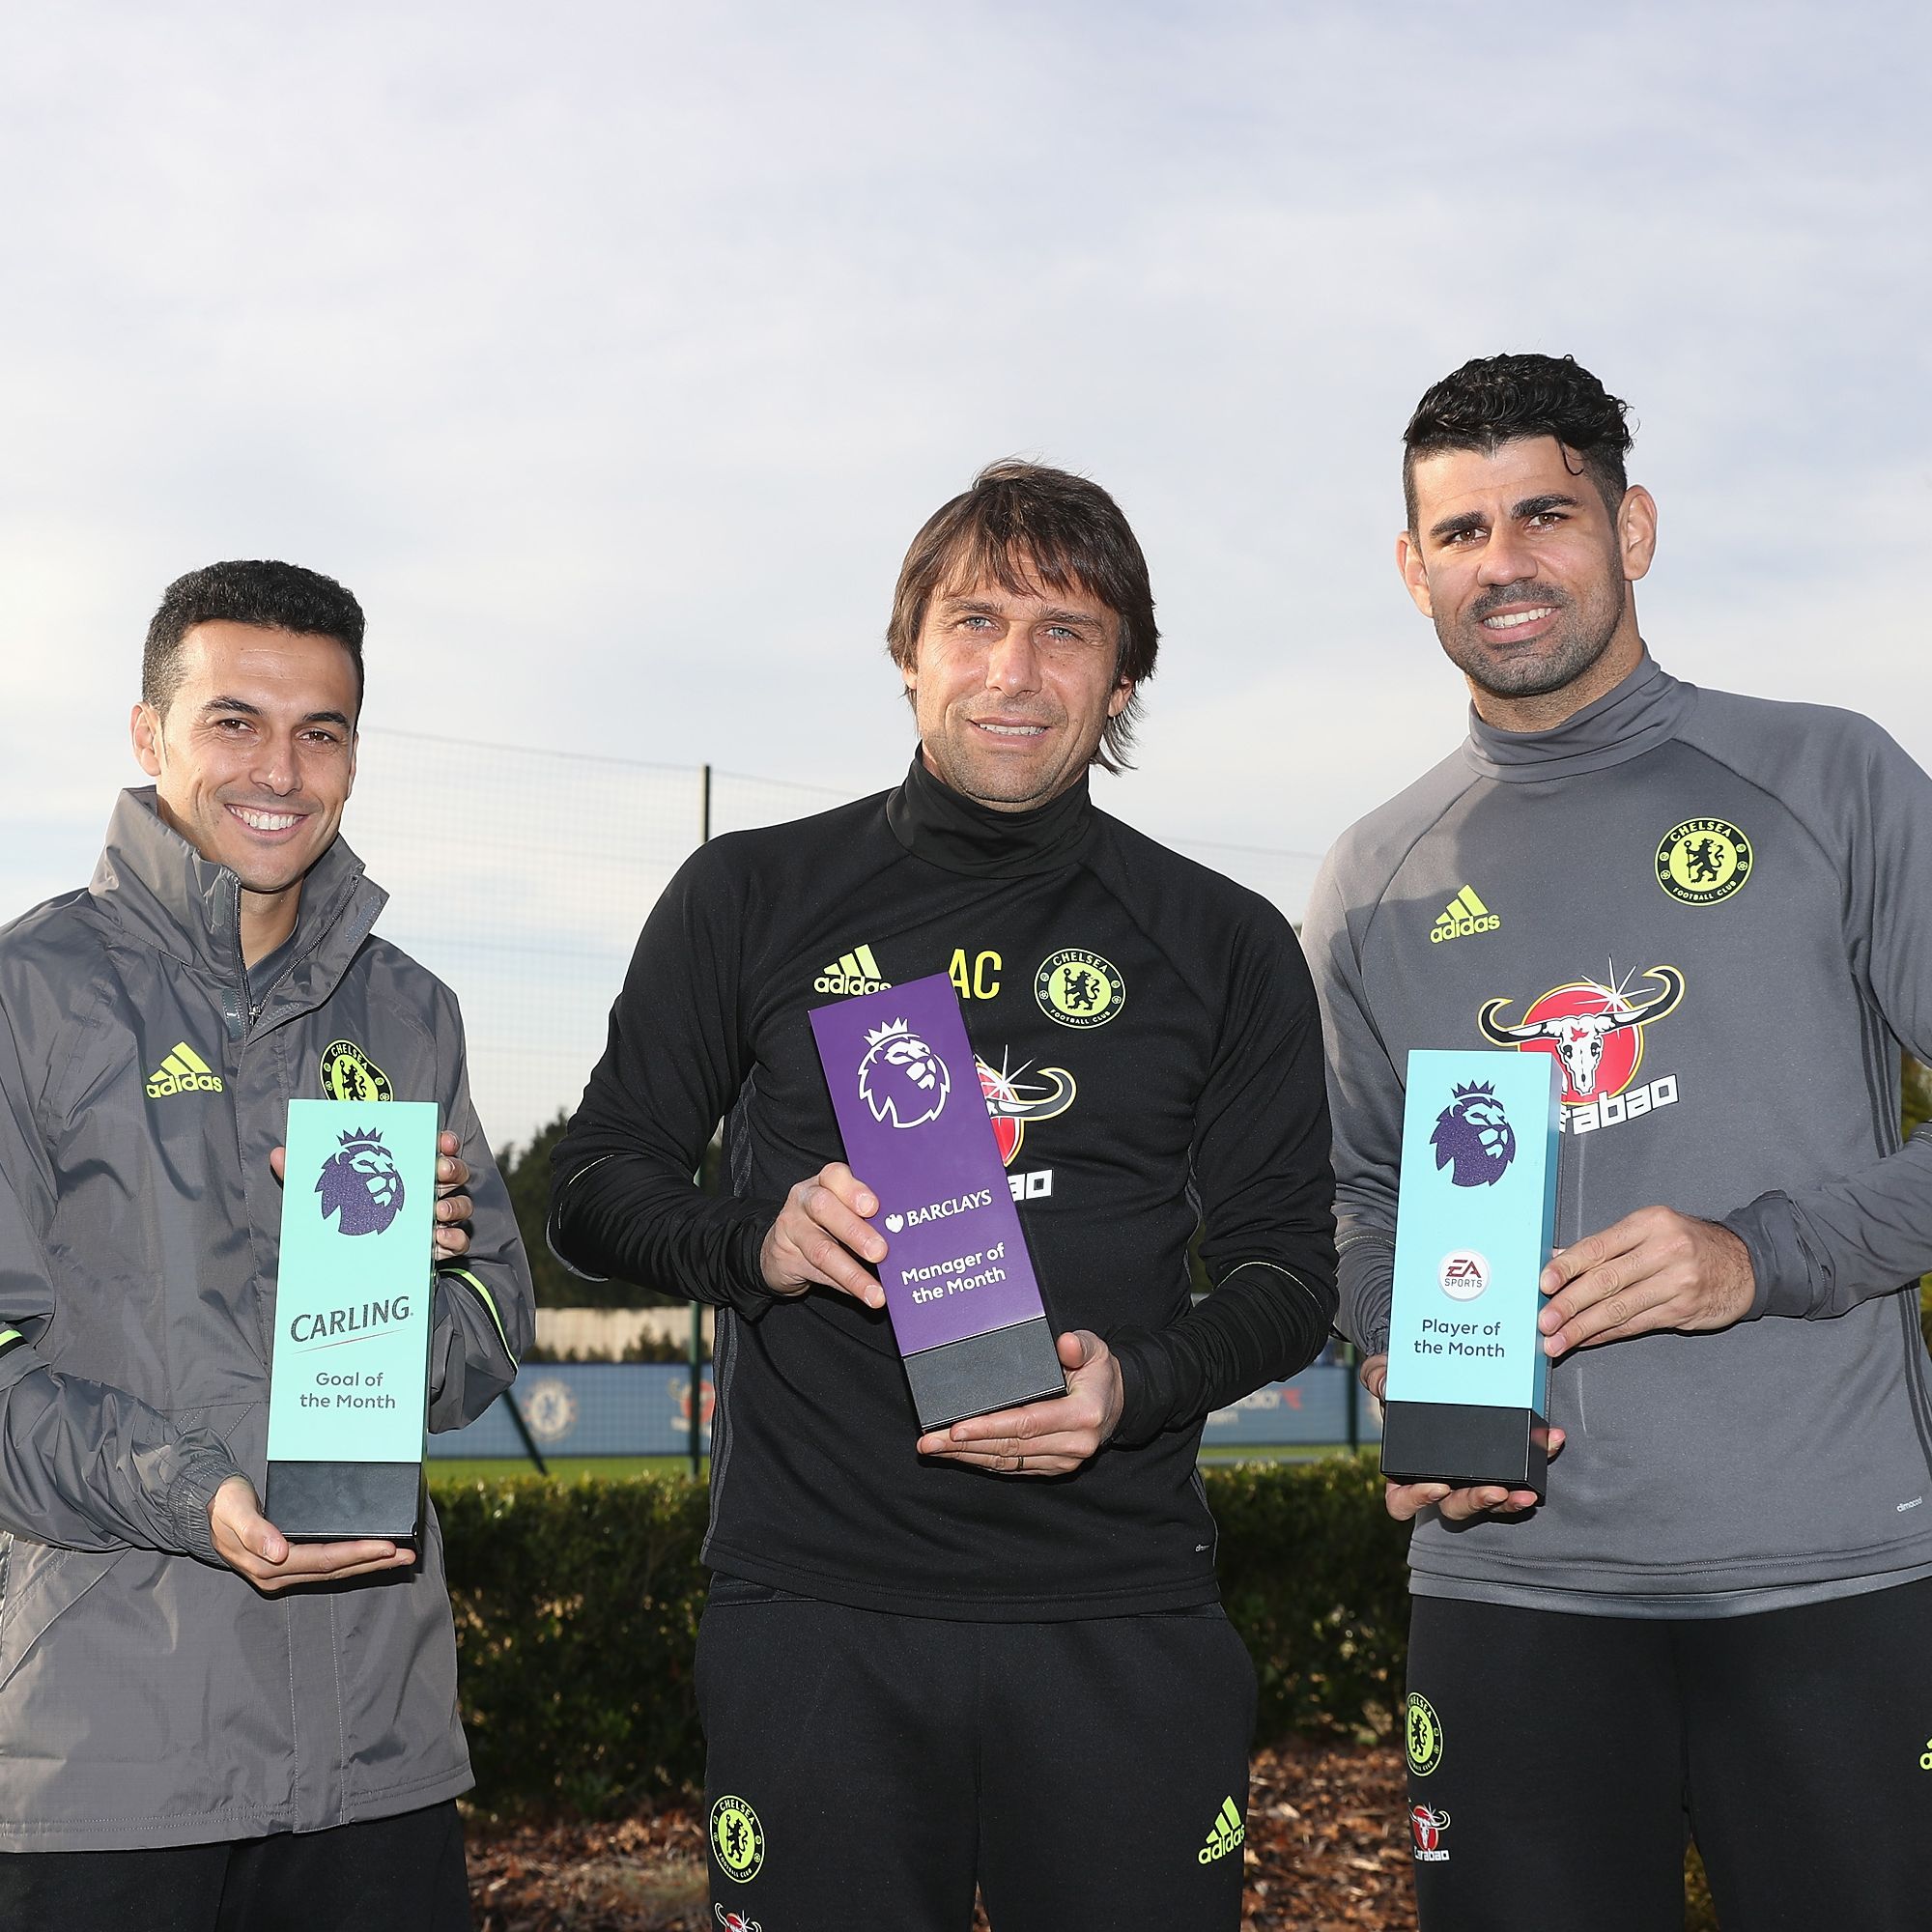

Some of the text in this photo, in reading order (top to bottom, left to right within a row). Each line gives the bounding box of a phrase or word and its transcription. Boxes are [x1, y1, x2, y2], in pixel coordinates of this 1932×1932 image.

[1669, 820, 1732, 842] CHELSEA
[1671, 880, 1737, 901] FOOTBALL CLUB
[1430, 914, 1501, 944] adidas
[948, 948, 1003, 1000] AC
[1052, 952, 1109, 974] CHELSEA
[1050, 1009, 1111, 1024] FOOTBALL CLUB
[330, 1043, 368, 1070] CHELSEA
[146, 1071, 223, 1098] adidas
[1559, 1073, 1680, 1135] rabao
[906, 1188, 992, 1227] BARCLAYS
[900, 1241, 1006, 1285] Manager of
[1445, 1259, 1482, 1278] EA
[912, 1266, 1007, 1304] the Month
[1444, 1278, 1483, 1289] SPORTS
[290, 1295, 410, 1343] CARLING
[1422, 1318, 1501, 1338] Player of
[1413, 1339, 1505, 1358] the Month
[316, 1372, 384, 1386] Goal of
[299, 1393, 396, 1409] the Month
[719, 1799, 754, 1825] CHELSEA
[1198, 1824, 1245, 1864] adidas
